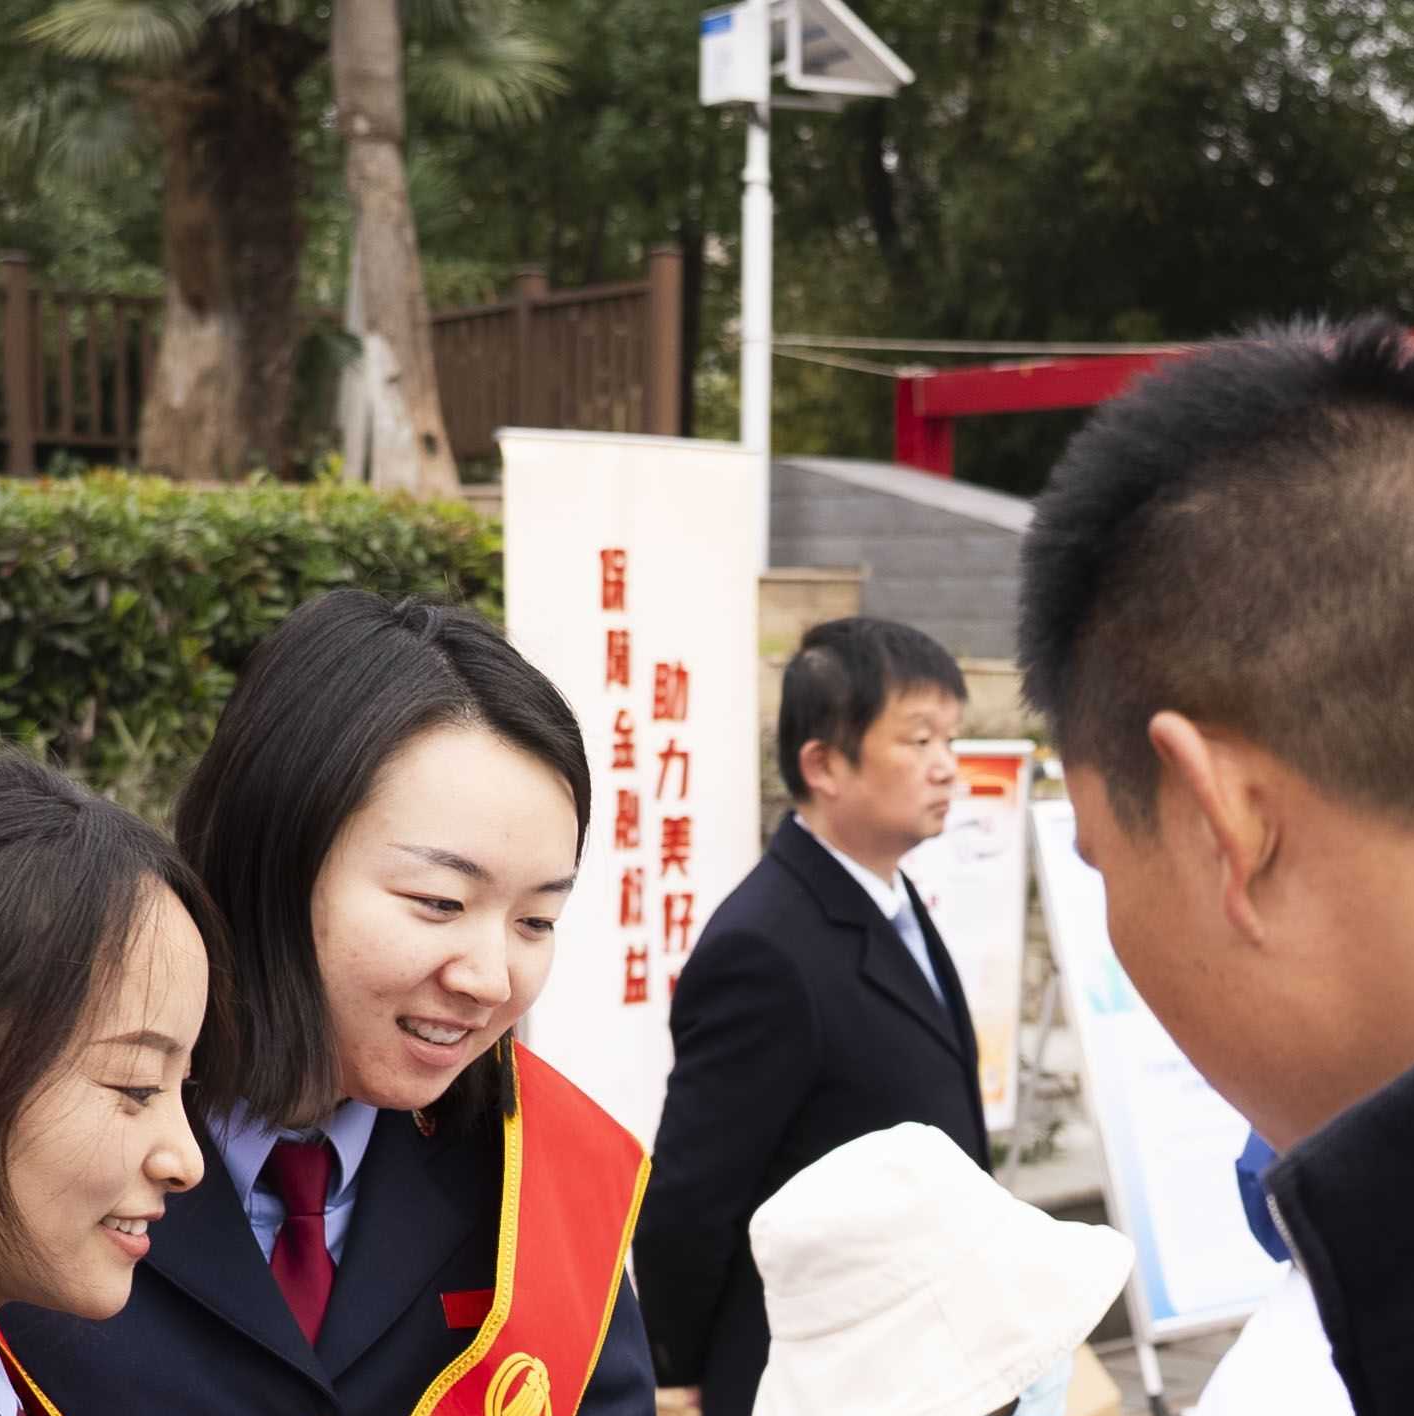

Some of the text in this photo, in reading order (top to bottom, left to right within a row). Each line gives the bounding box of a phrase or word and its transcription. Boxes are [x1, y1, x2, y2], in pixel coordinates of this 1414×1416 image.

[600, 548, 650, 1004] 保障金融权益
[652, 658, 694, 1000] 助力美好
